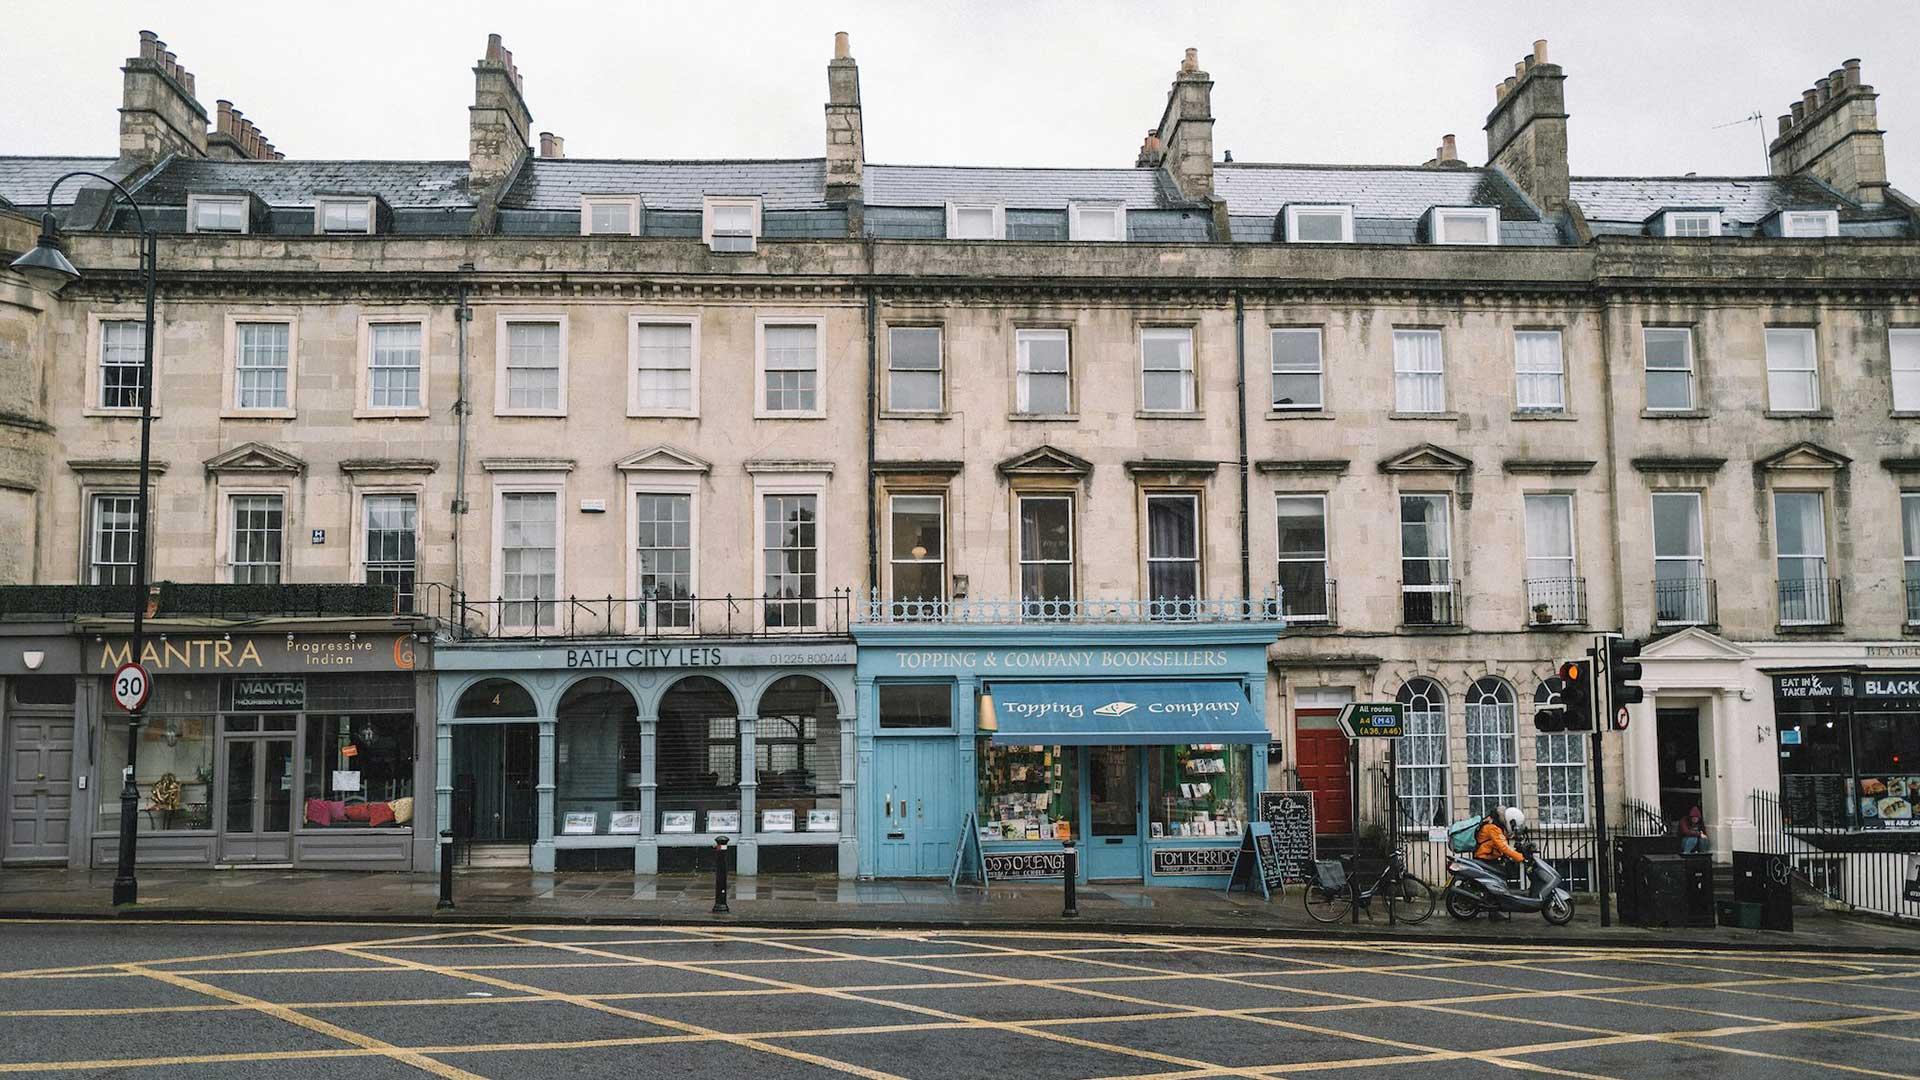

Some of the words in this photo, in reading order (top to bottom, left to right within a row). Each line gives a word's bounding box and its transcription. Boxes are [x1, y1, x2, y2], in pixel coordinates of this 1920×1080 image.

[286, 640, 373, 653] Progressive
[100, 639, 263, 669] MANTRA
[305, 653, 353, 665] Indian
[566, 649, 618, 668] BATH
[625, 648, 672, 667] CITY
[679, 647, 721, 666] LETS
[770, 654, 804, 664] 01225
[896, 652, 976, 669] TOPPING
[983, 652, 997, 667] &
[1004, 651, 1094, 667] COMPANY
[1101, 650, 1228, 667] BOOKSELLERS
[118, 677, 142, 696] 30
[239, 683, 304, 694] MANTRA
[1781, 678, 1799, 687] EAT
[1801, 678, 1811, 687] IN
[1782, 688, 1806, 697] TAKE
[1808, 687, 1834, 697] AWAY
[491, 693, 500, 705] 4
[1003, 702, 1084, 718] Topping
[1148, 701, 1240, 717] Company
[1374, 717, 1394, 725] (M4)
[985, 855, 1065, 871] OTTOLENG
[1157, 852, 1183, 865] TOM
[1188, 850, 1238, 865] KERRIDG
